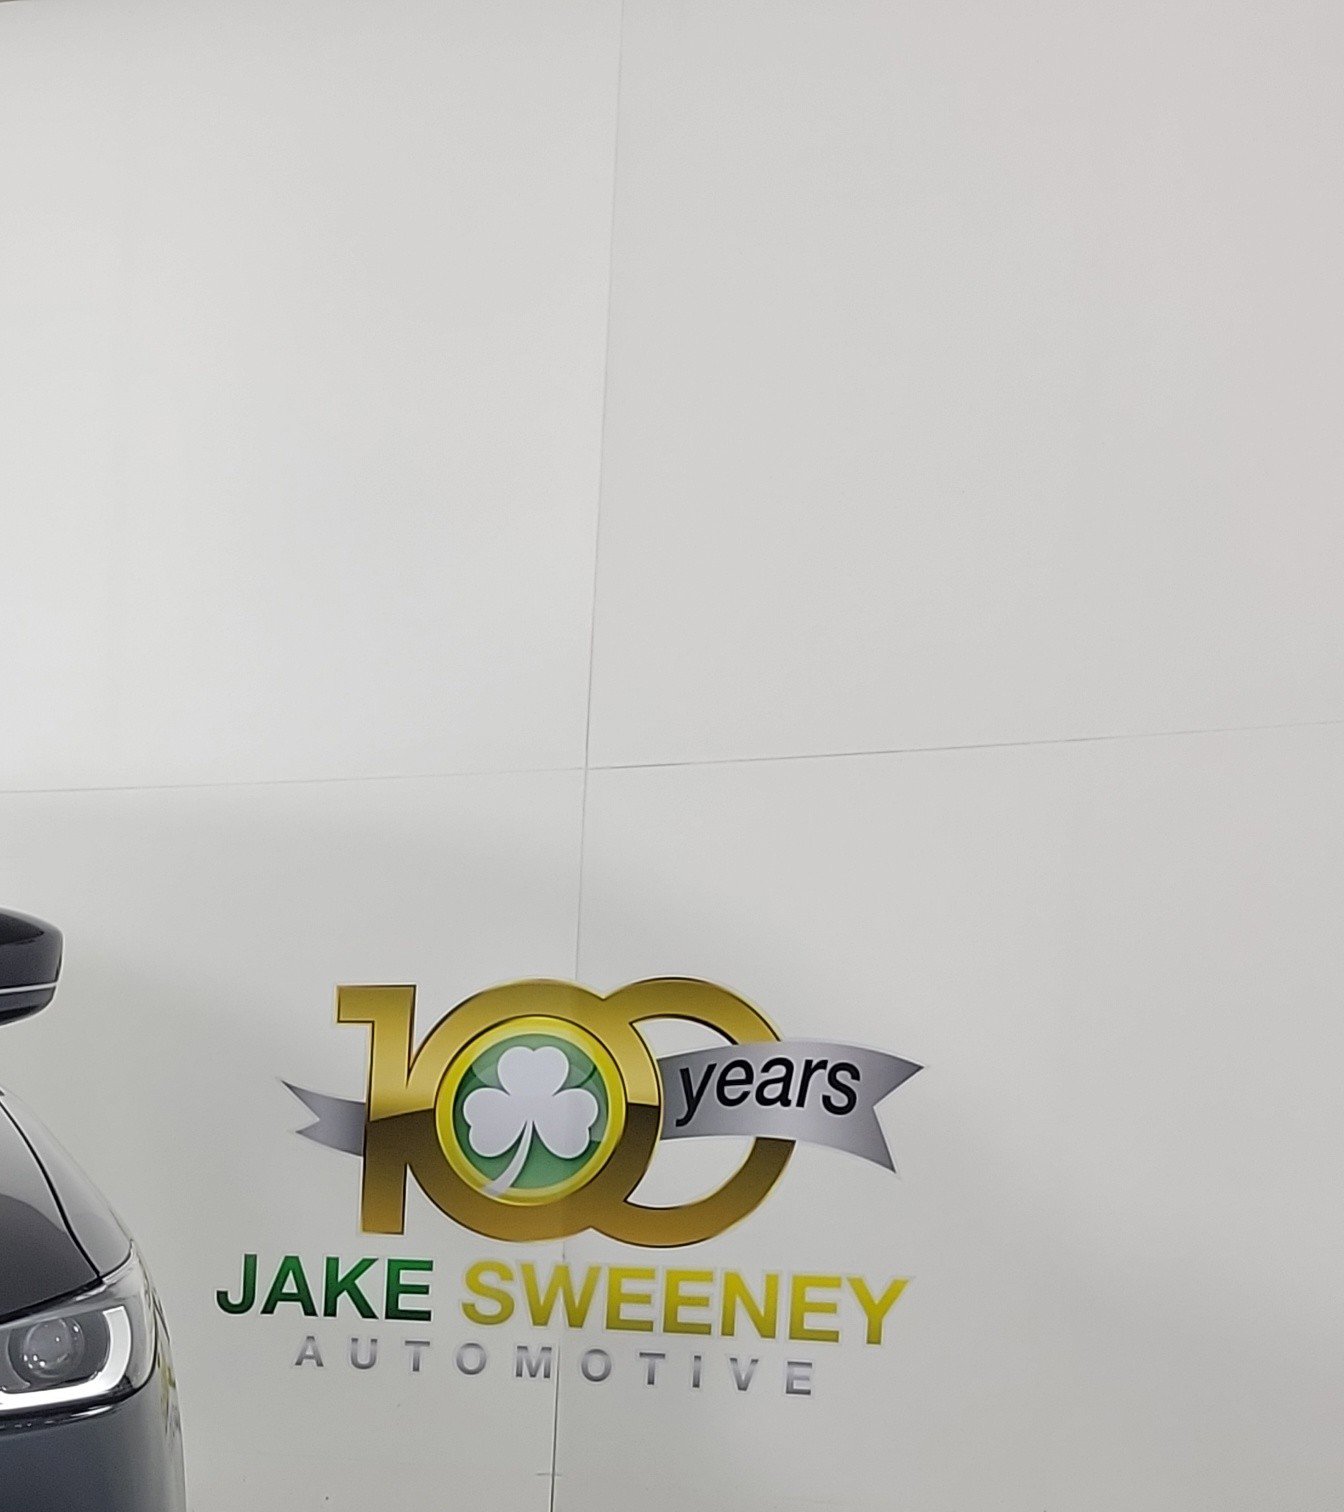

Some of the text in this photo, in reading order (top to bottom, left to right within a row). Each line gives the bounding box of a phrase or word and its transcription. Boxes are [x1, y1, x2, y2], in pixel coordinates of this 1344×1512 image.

[335, 976, 862, 1248] 100 years
[215, 1253, 910, 1345] JAKE SWEENEY
[294, 1334, 813, 1397] AUTOMOTIVE
